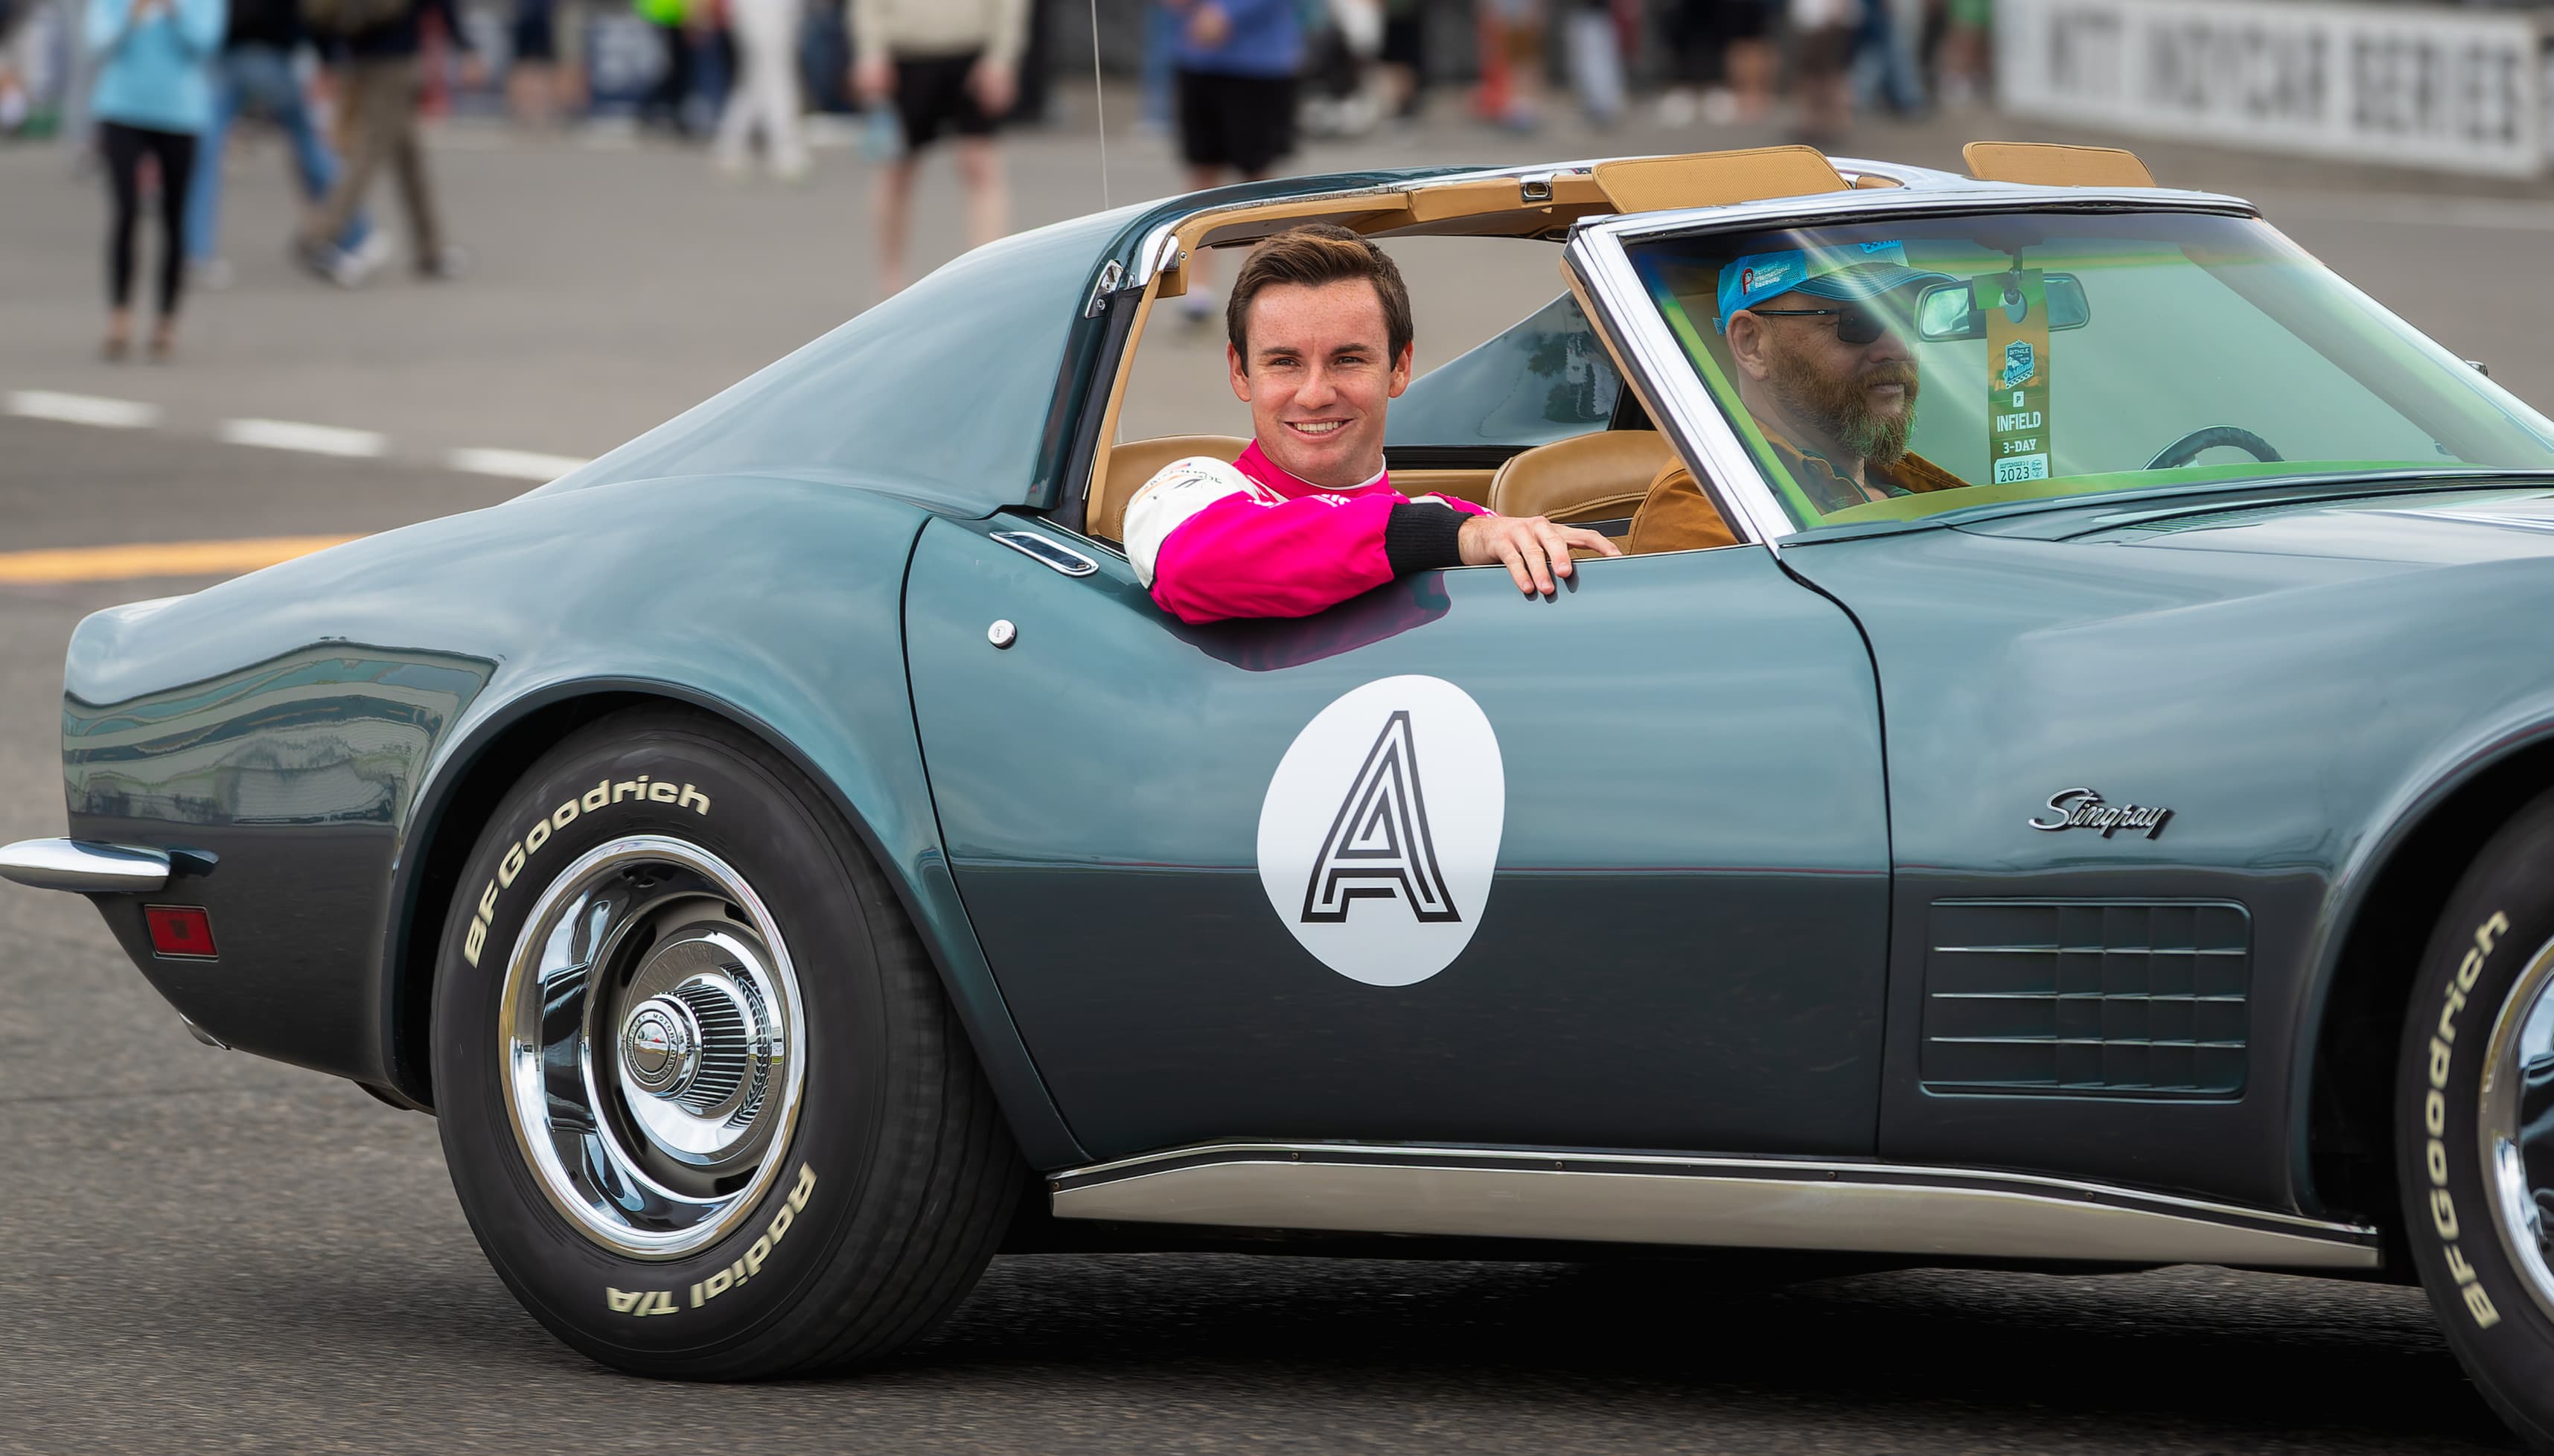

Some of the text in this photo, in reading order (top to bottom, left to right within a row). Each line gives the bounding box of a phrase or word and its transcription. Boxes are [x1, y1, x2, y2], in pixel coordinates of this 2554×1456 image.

[1996, 411, 2041, 432] INFIELD
[2016, 395, 2021, 403] P
[2003, 438, 2037, 454] 3-DAY
[2000, 466, 2030, 482] 2023
[1300, 710, 1462, 923] A
[2028, 786, 2168, 839] Stingray
[464, 775, 711, 968] BFGoodrich
[2425, 910, 2511, 1330] BFGoodrich
[605, 1160, 817, 1318] Radial T/A
